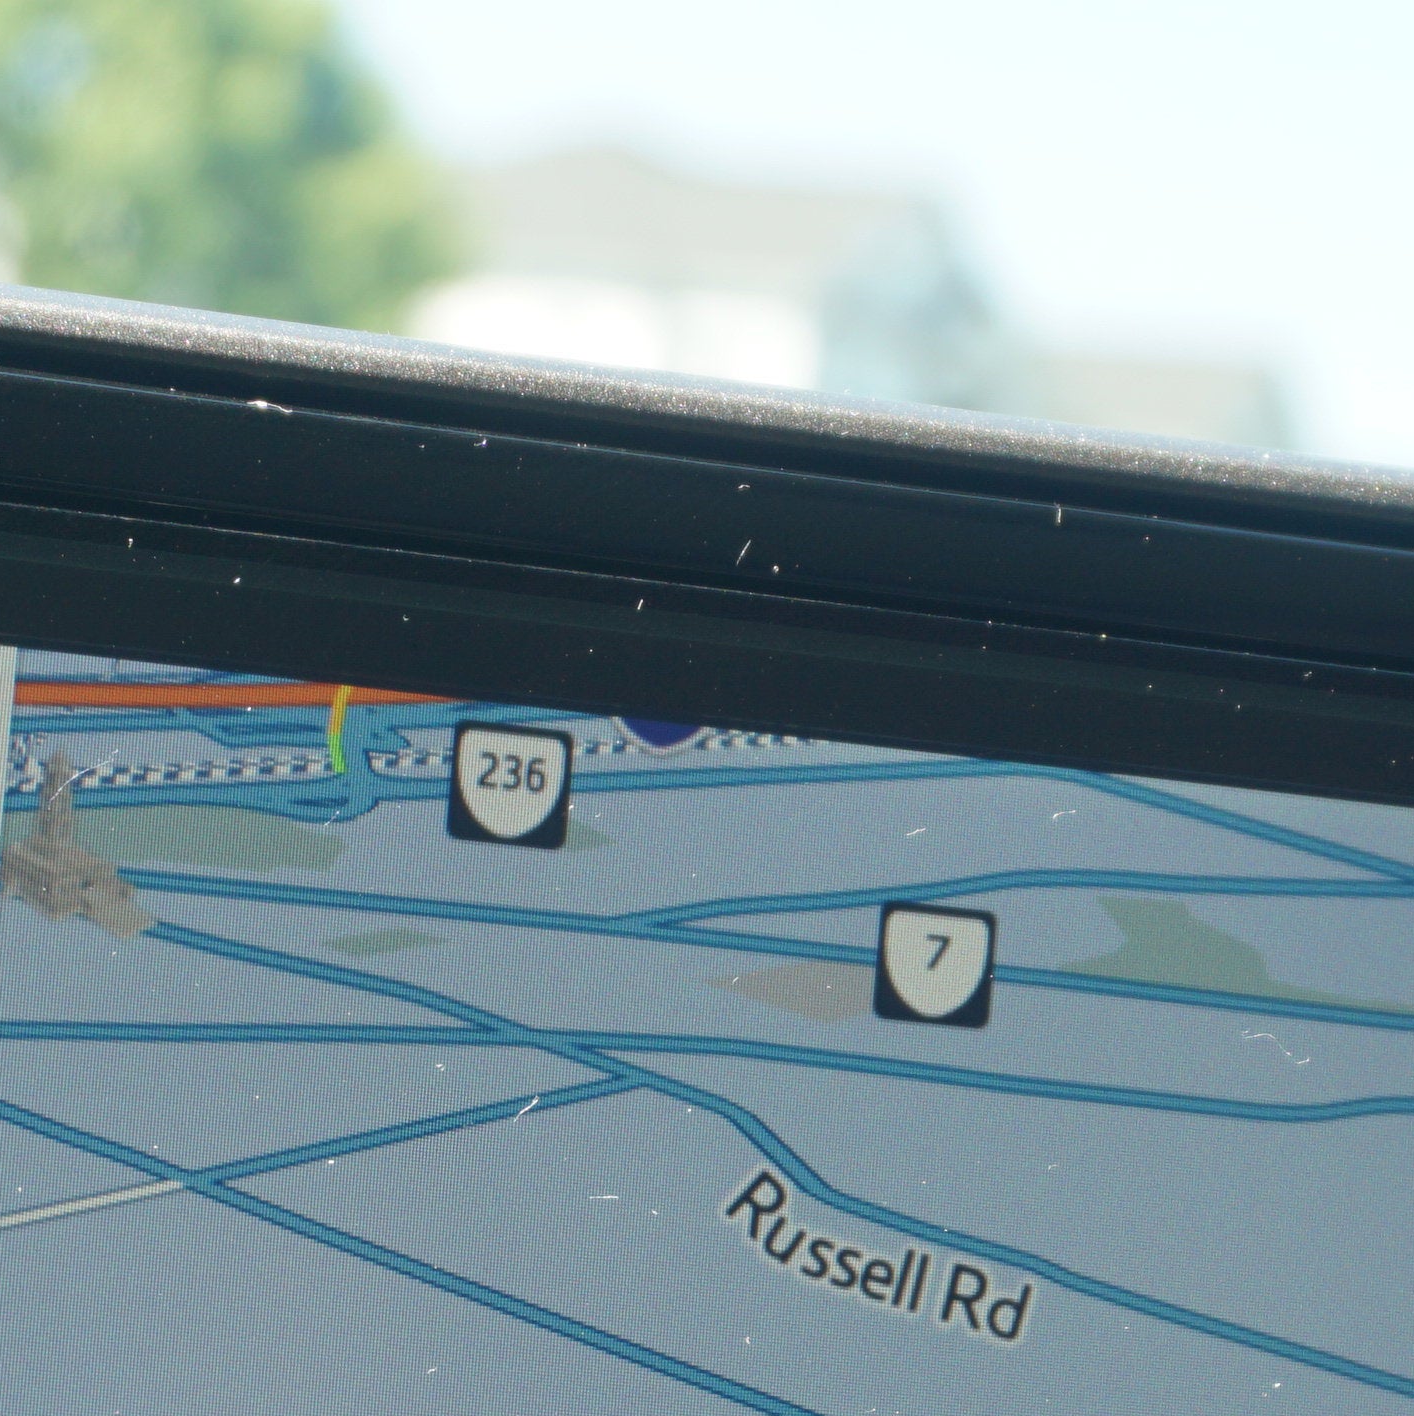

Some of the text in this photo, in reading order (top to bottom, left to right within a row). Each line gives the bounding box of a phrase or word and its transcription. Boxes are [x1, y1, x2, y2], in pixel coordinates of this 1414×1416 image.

[476, 751, 547, 793] 236
[923, 934, 950, 971] 7
[725, 1170, 1033, 1340] Russell Rd
